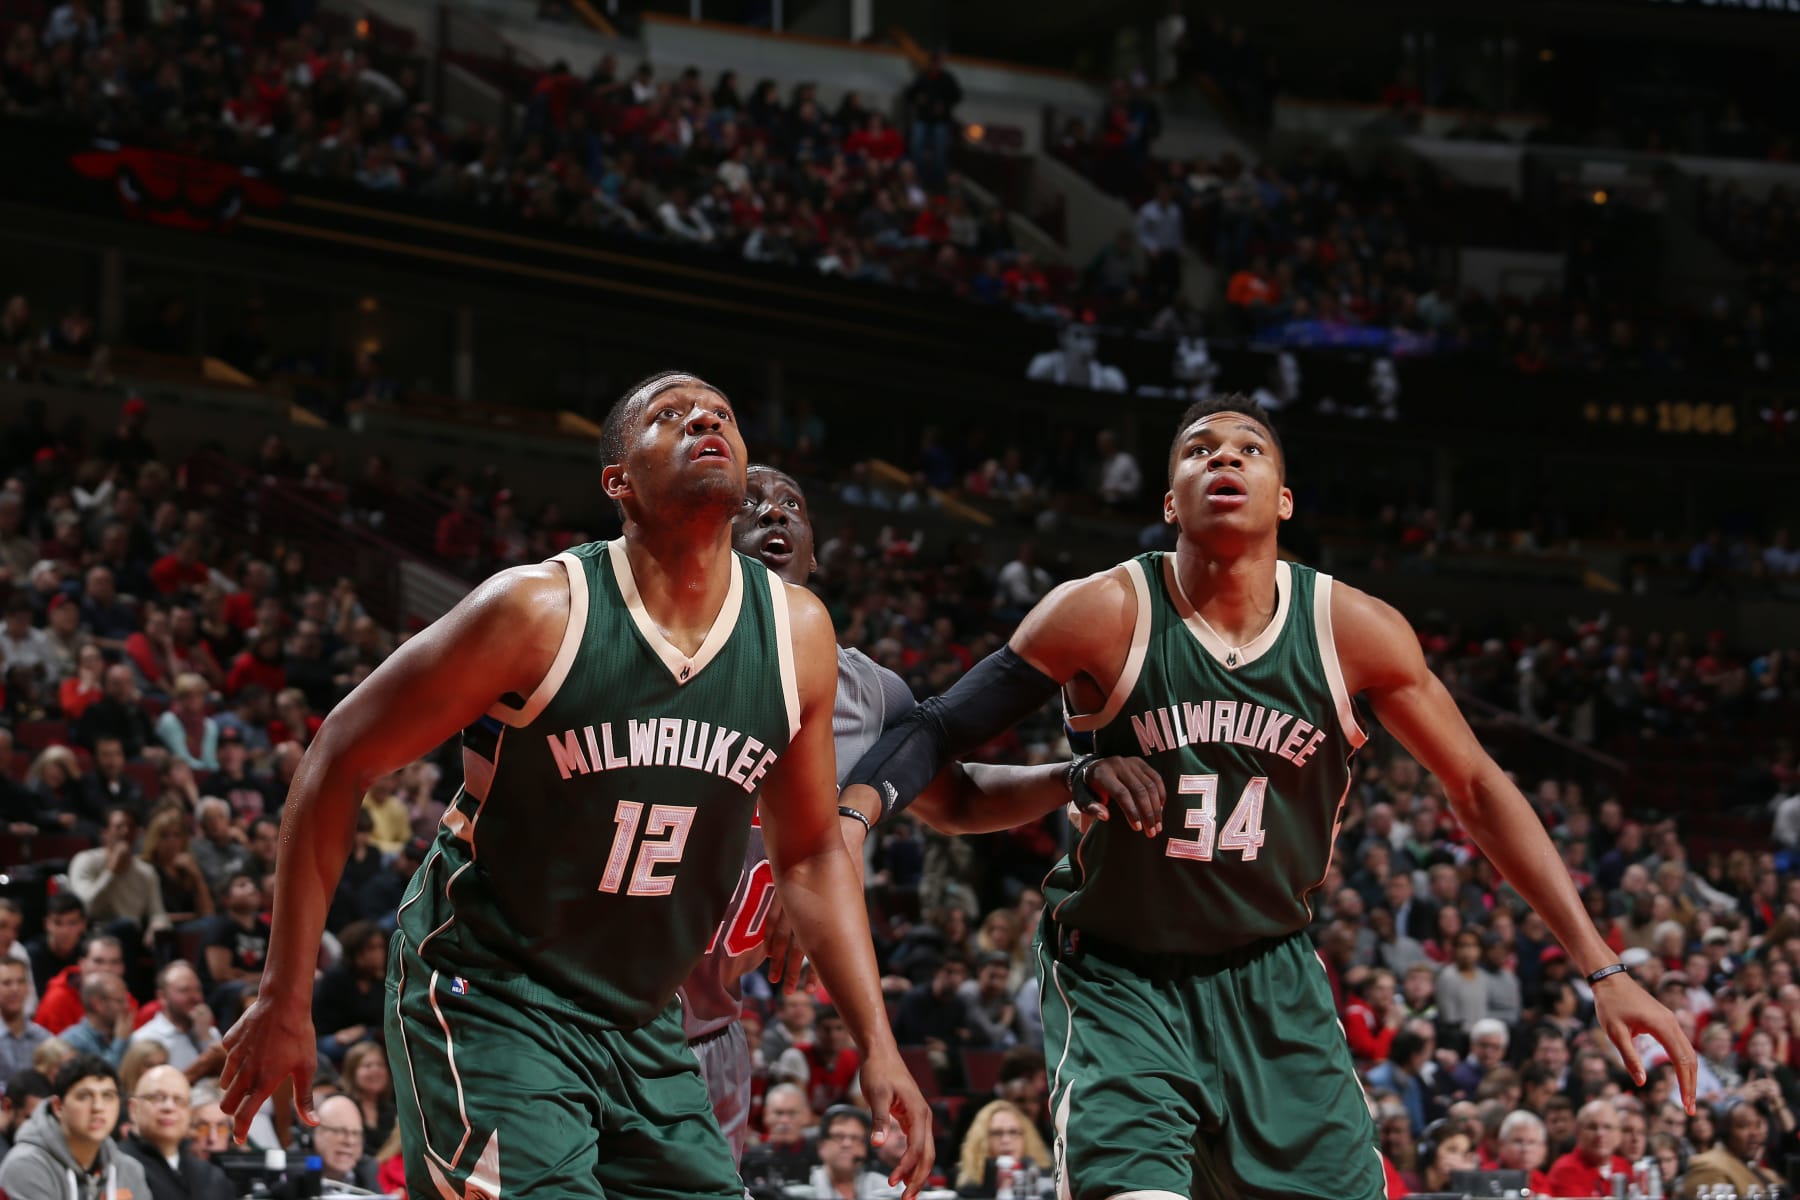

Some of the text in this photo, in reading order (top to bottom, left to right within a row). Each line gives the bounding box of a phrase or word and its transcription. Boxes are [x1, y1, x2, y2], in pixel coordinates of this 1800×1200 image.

[1656, 402, 1735, 435] 1966
[546, 718, 778, 794] MILWAUKEE
[1131, 701, 1327, 768] MILWAUKEE
[598, 800, 698, 897] 12
[1165, 774, 1269, 862] 34
[704, 859, 777, 958] 0
